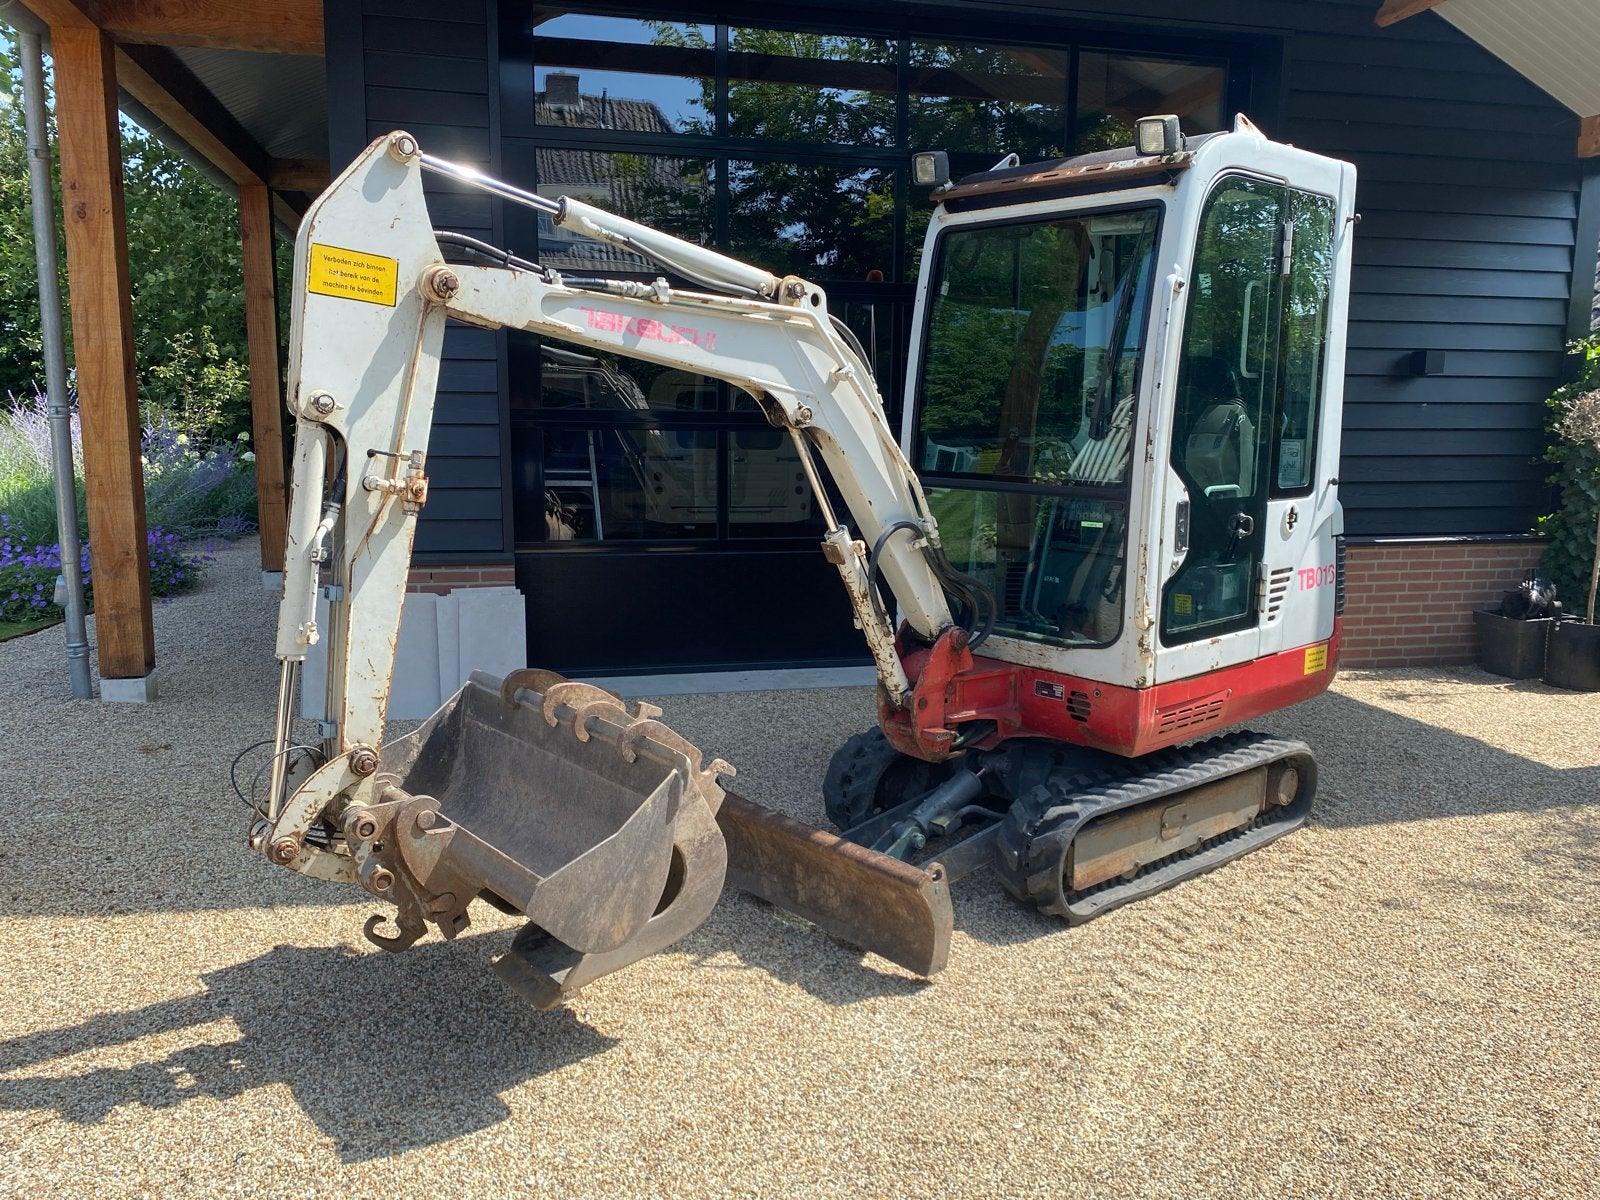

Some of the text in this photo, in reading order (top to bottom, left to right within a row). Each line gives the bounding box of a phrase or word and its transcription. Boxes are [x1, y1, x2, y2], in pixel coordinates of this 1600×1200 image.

[323, 254, 385, 272] Verboden zich binnen
[340, 270, 358, 279] bereik
[323, 281, 348, 290] machine
[357, 286, 383, 296] bevinden
